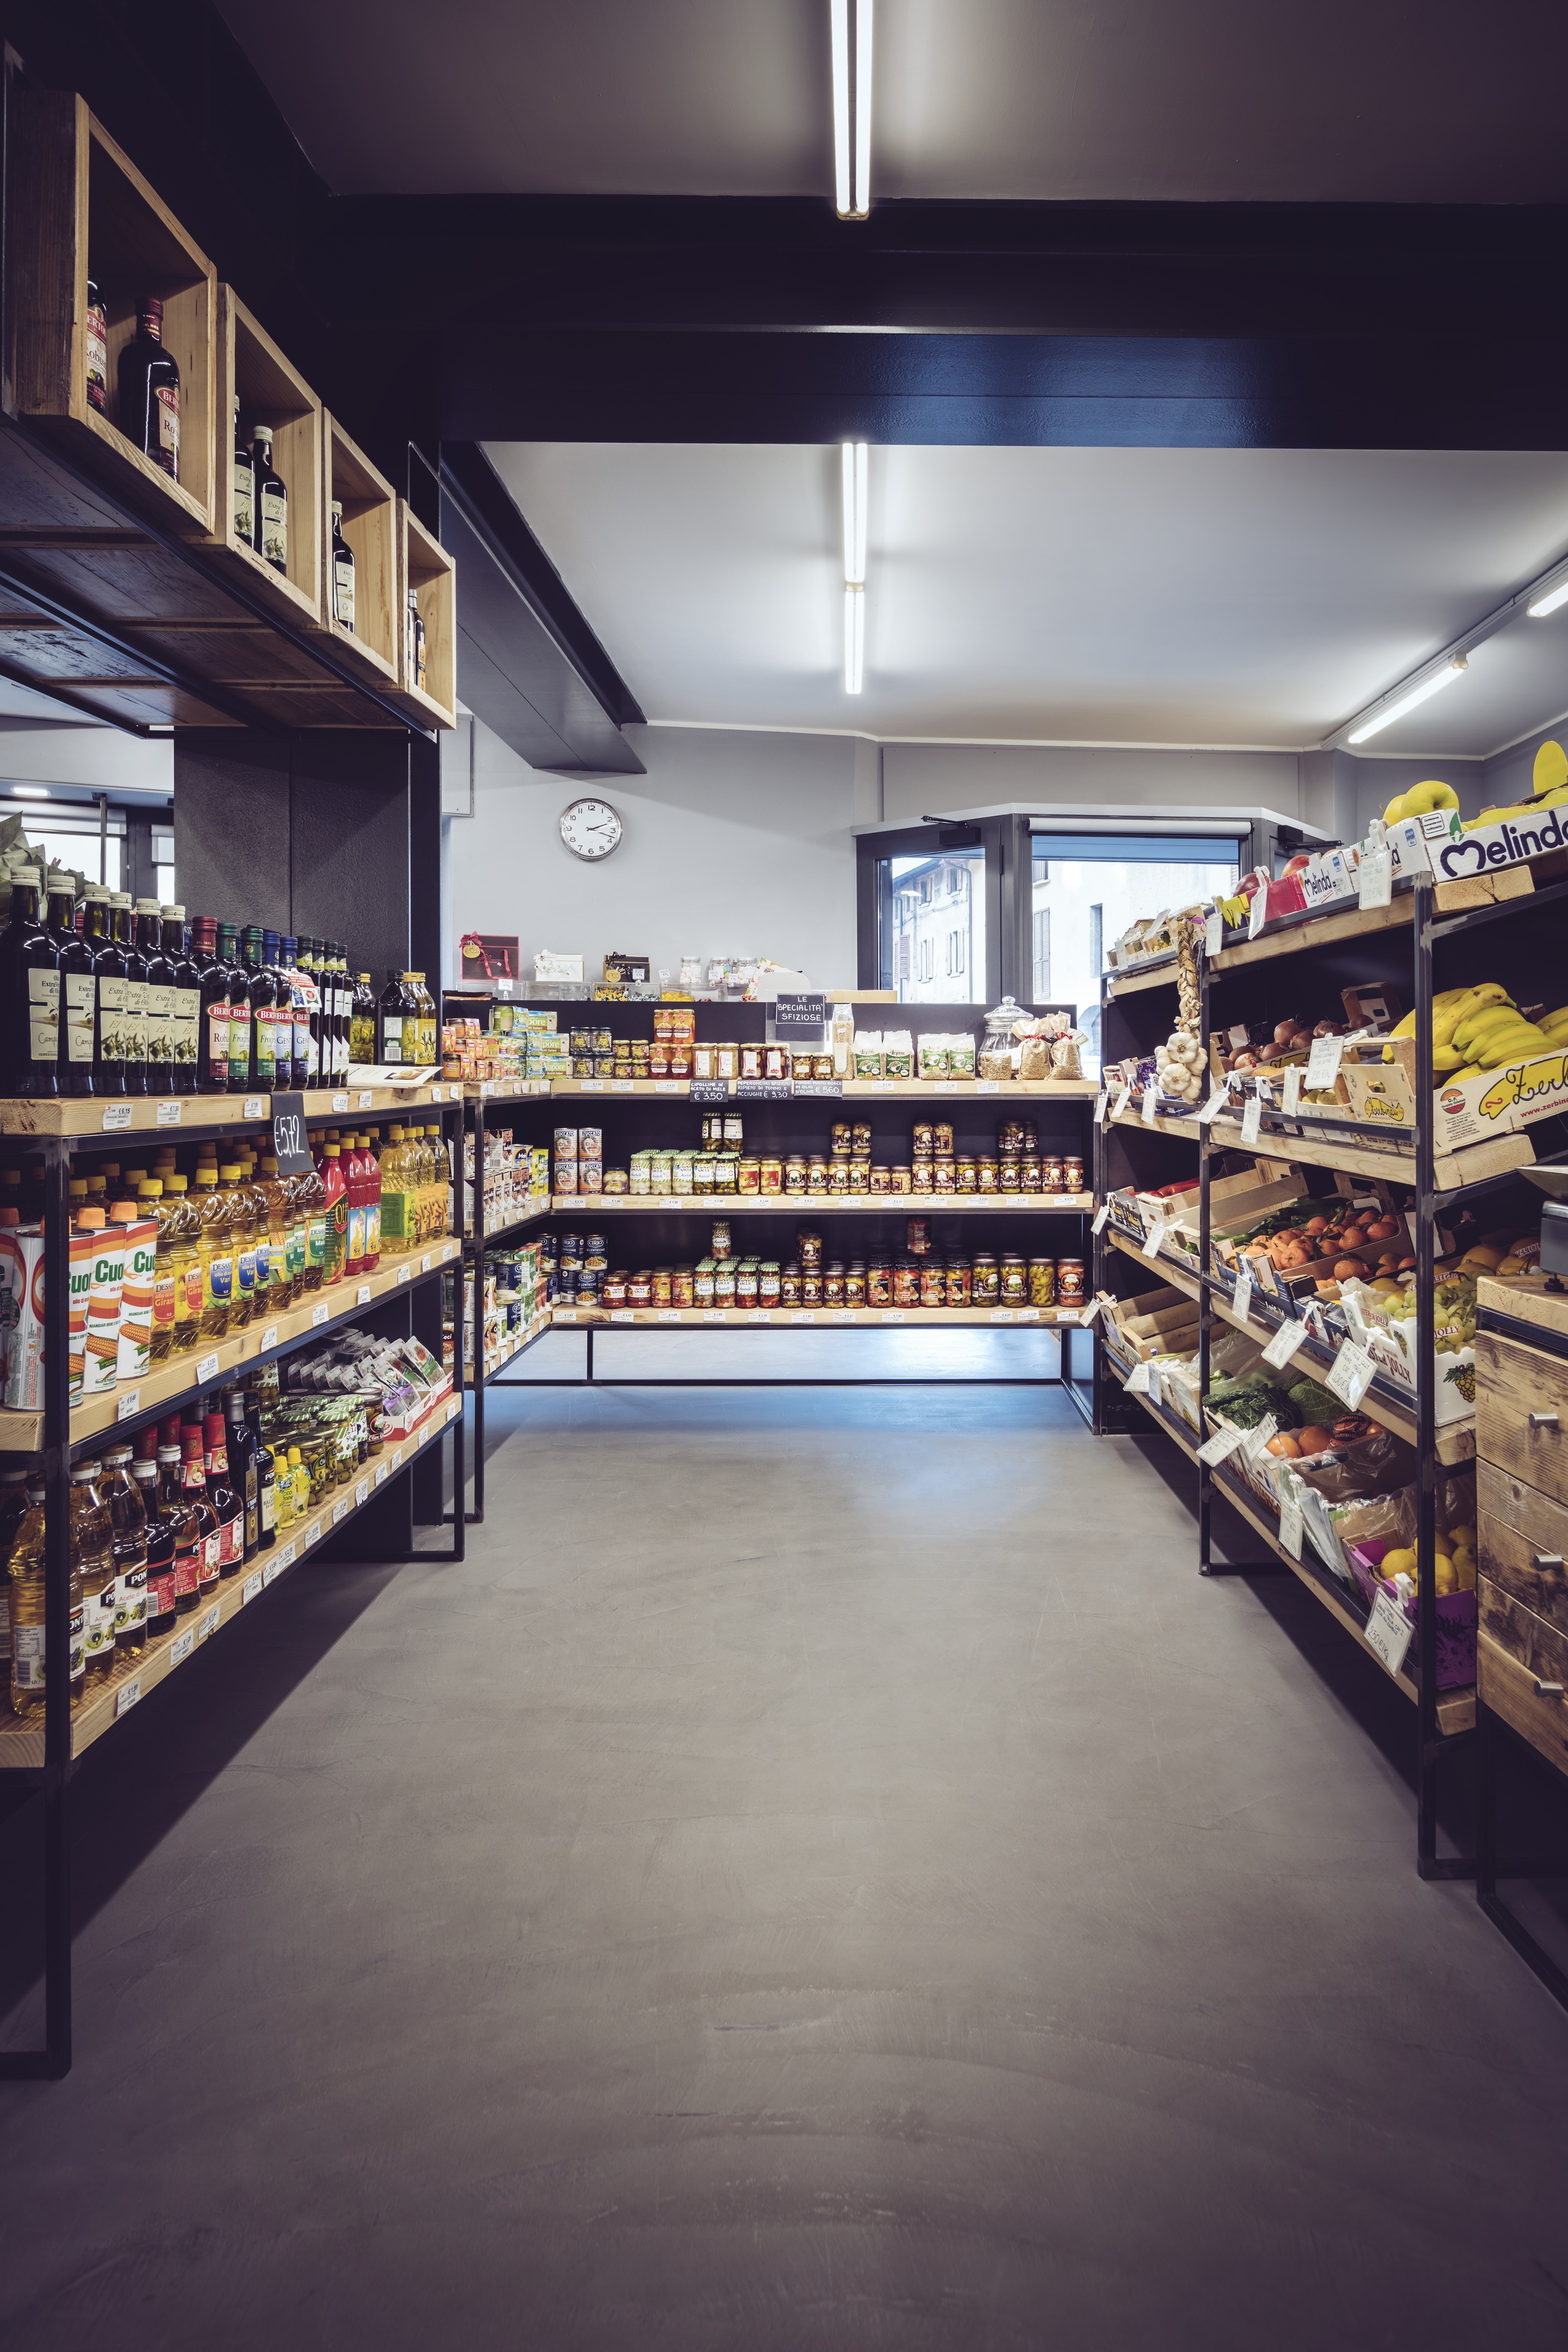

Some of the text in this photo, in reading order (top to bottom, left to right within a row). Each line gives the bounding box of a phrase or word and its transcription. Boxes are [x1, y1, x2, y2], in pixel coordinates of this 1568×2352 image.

[1304, 868, 1332, 897] Melinda
[781, 1013, 822, 1021] SFIZIOSE
[694, 1092, 723, 1100] € 3,50
[823, 1086, 839, 1094] 5,60
[1375, 1314, 1389, 1327] JOLLY
[1434, 1325, 1460, 1338] JOLLY
[1386, 1354, 1412, 1385] JOLLY
